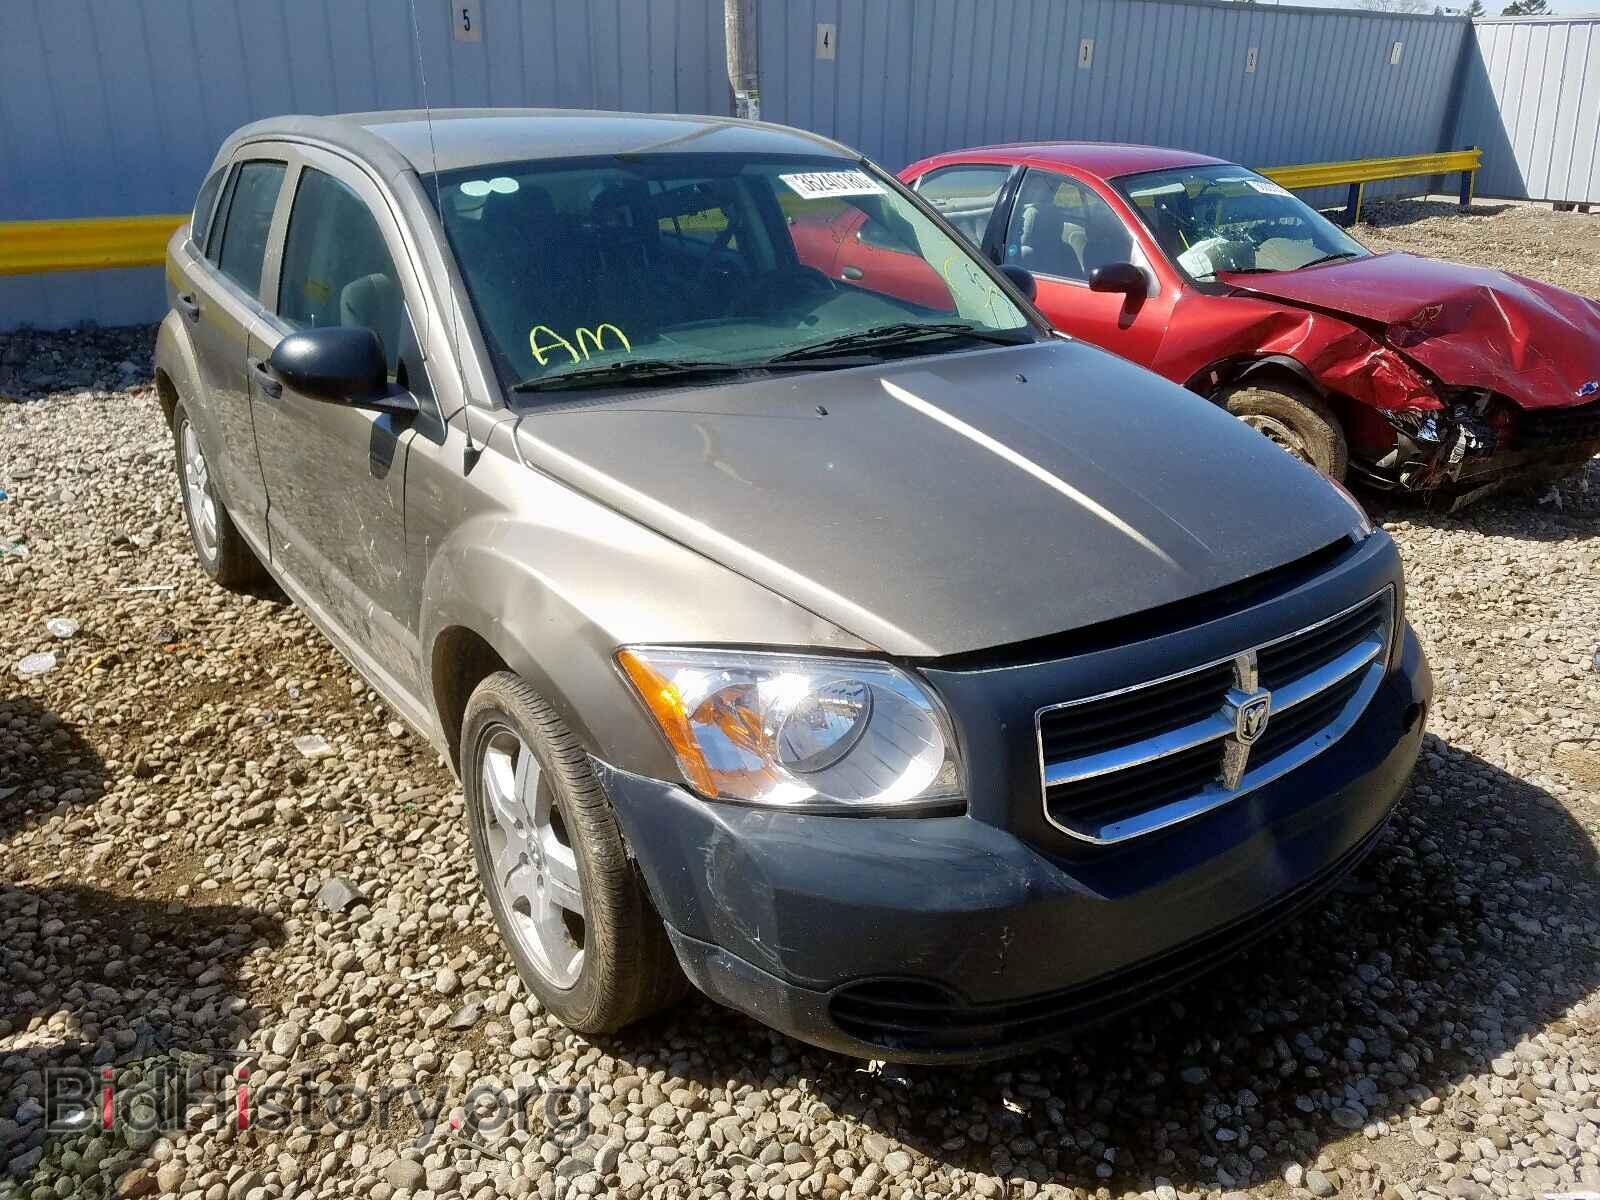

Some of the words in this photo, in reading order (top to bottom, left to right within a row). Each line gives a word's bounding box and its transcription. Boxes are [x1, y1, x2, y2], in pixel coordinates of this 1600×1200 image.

[462, 8, 471, 32] 5
[823, 31, 830, 49] 4
[1082, 46, 1089, 62] 3
